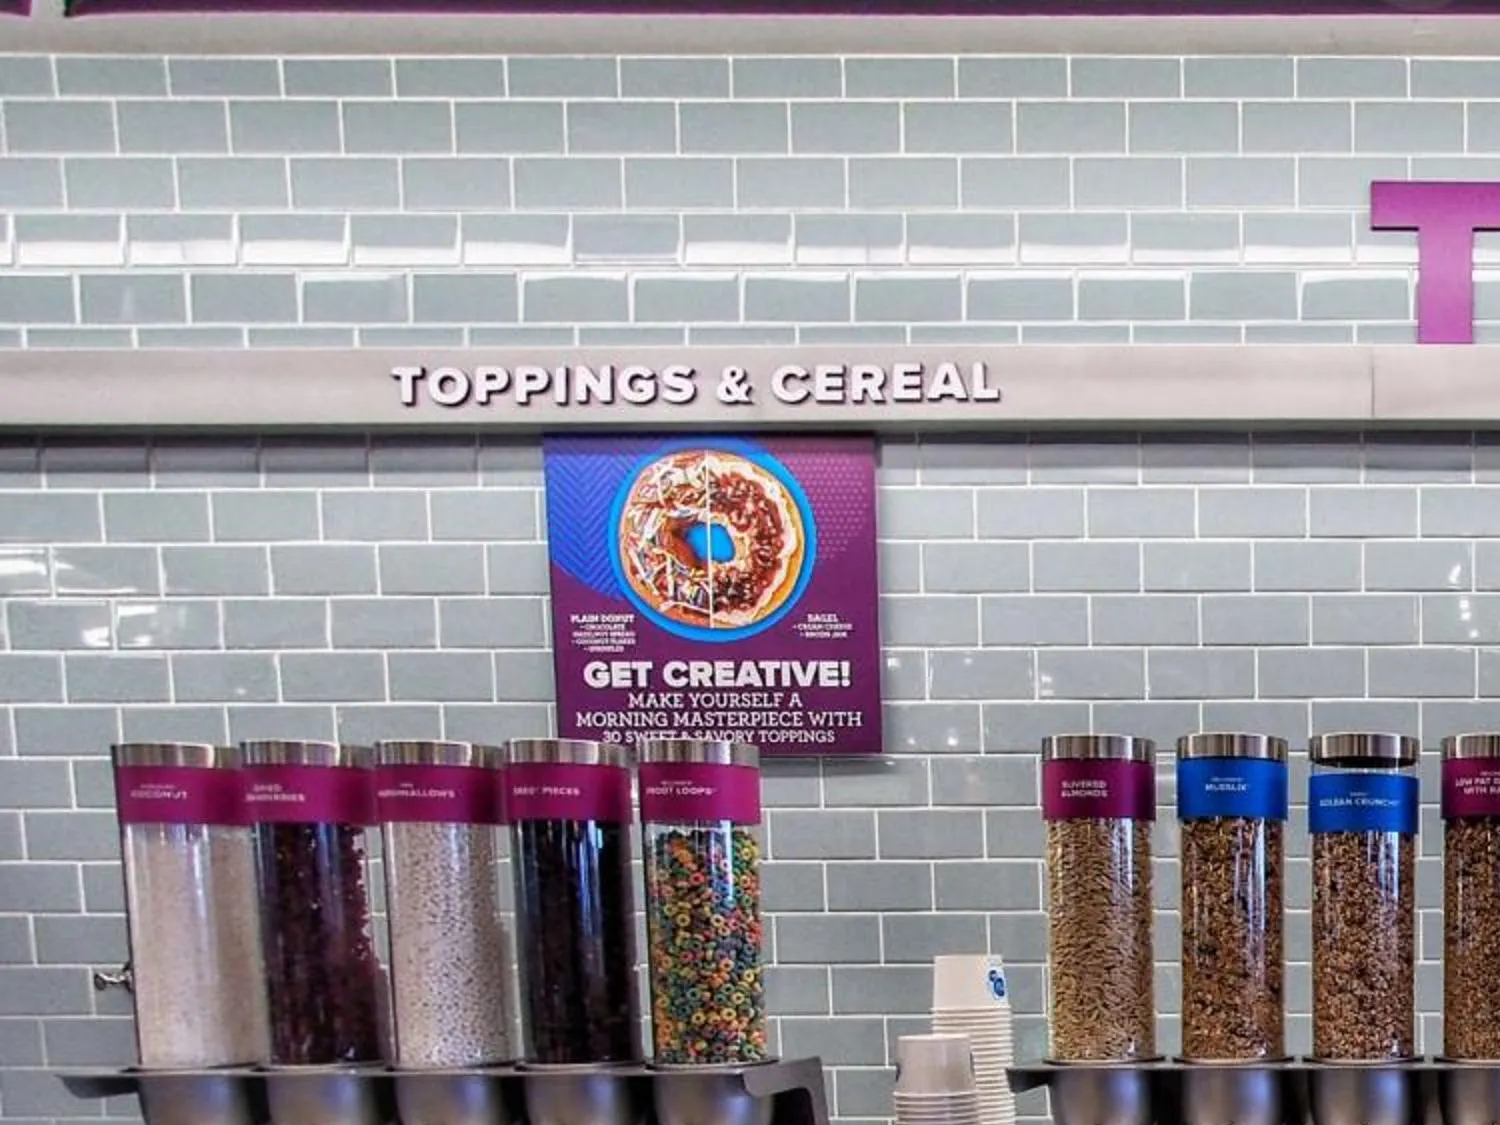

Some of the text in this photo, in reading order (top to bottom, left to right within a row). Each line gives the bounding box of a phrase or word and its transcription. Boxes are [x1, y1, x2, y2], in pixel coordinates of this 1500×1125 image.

[391, 362, 1001, 406] TOPPINGS & CEREAL
[583, 661, 851, 688] GET CREATIVE!
[628, 692, 802, 708] MAKE YOURSELF A
[576, 711, 862, 727] MORNING MASTERPIECE WITH
[602, 731, 621, 743] 30
[693, 731, 754, 743] SAVORY
[757, 731, 835, 743] TOPPINGS
